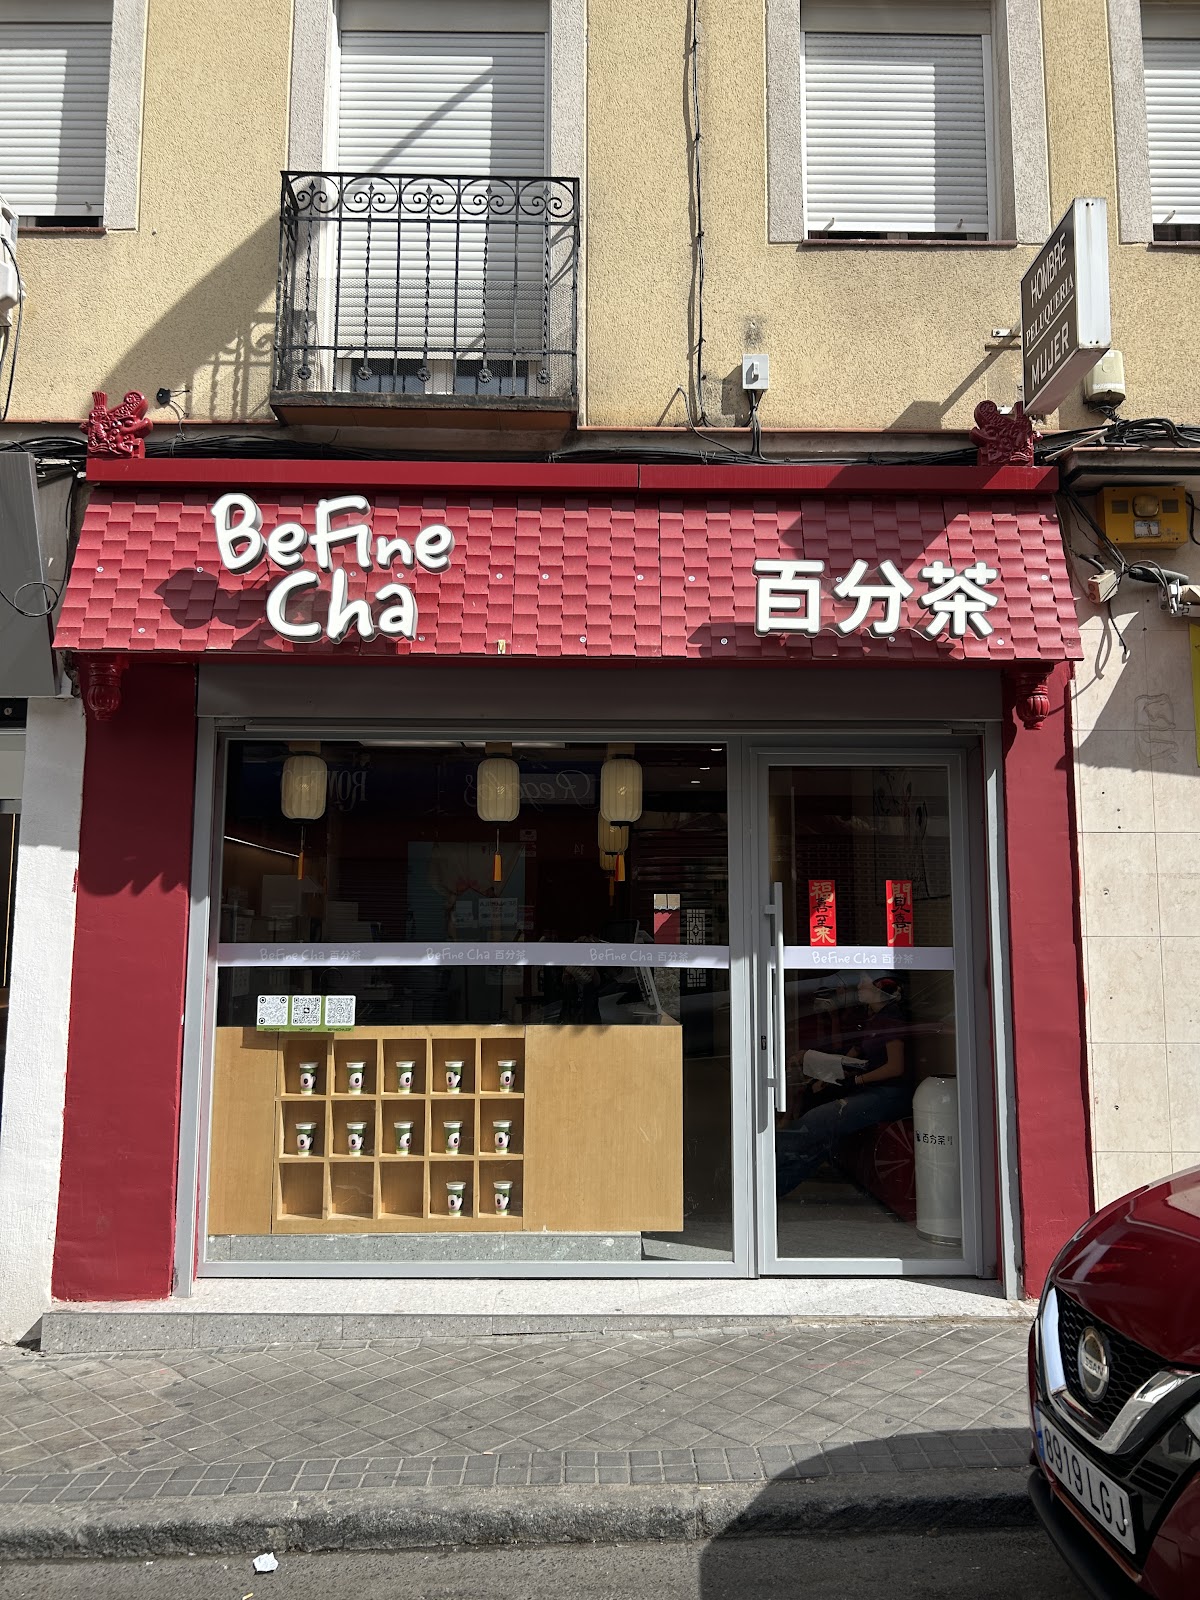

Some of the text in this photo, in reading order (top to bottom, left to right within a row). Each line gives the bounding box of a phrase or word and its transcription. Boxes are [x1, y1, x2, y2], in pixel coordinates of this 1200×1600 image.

[1030, 232, 1067, 309] HOMBRE
[1025, 272, 1075, 348] PELUQUERIA
[1031, 321, 1070, 391] MUJER
[211, 493, 455, 575] BeFine
[266, 568, 418, 644] Cha
[753, 559, 999, 641] 百分茶
[259, 947, 361, 962] BeFine Cha 百分茶
[425, 946, 527, 961] BeFine Cha 百分茶
[589, 947, 689, 963] BeFine Cha 百分茶
[811, 950, 851, 965] BeFine
[853, 951, 878, 965] Cha
[1044, 1425, 1127, 1538] 8919 LGJ
